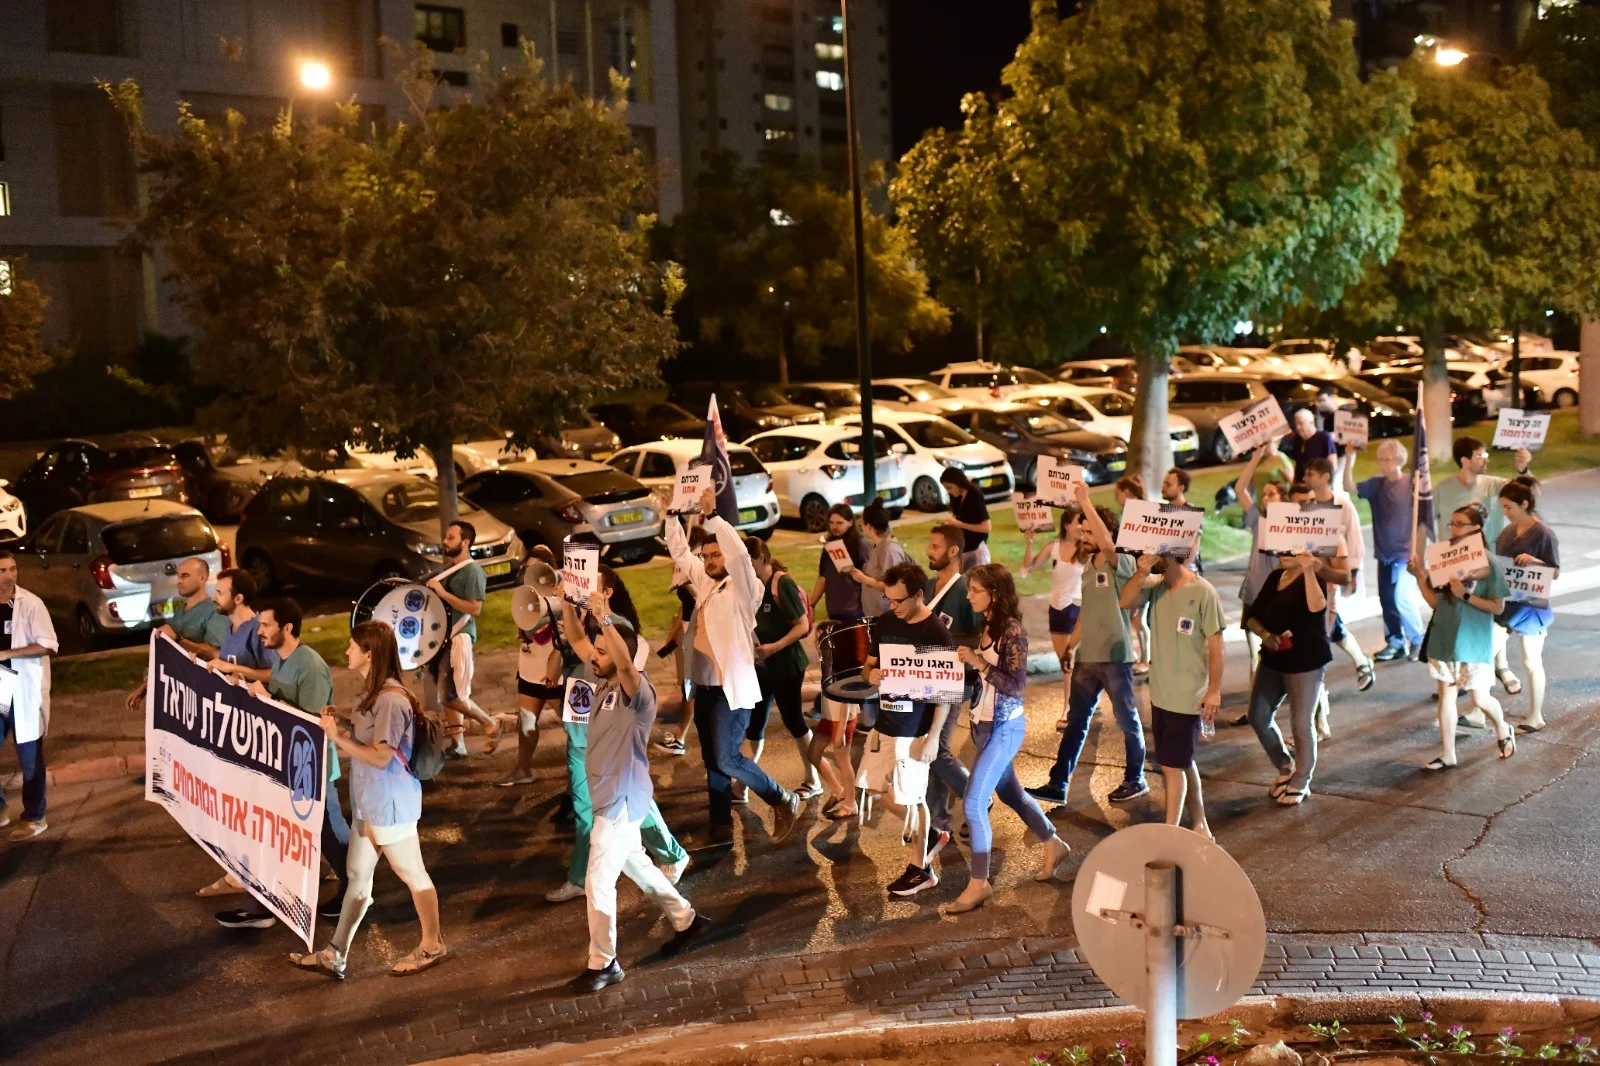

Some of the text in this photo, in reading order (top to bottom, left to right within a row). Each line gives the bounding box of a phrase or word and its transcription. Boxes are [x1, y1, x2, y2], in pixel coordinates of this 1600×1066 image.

[1231, 407, 1270, 431] זה קיצור
[1508, 418, 1542, 429] זה קיצור
[1233, 421, 1267, 443] מלחמה
[1500, 429, 1532, 439] מלחמה
[1048, 469, 1070, 481] מכרתם
[1050, 480, 1067, 491] אותנו
[1038, 511, 1048, 519] או
[1142, 515, 1184, 528] אין קיצור
[1285, 516, 1325, 526] אין קיצור
[1123, 522, 1195, 538] אין מתמחים/ות
[1269, 525, 1338, 536] אין מתמחים/ות
[574, 558, 587, 571] זה
[1505, 567, 1542, 580] זה קיצ
[580, 576, 590, 589] או
[1531, 584, 1544, 593] או
[890, 657, 954, 669] האגו שלכם
[881, 668, 964, 681] עולה בחיי אדם
[572, 685, 590, 708] 26
[160, 663, 283, 772] ממשלת ישראל
[293, 740, 312, 801] 26
[173, 760, 313, 870] הפקירה את המתמחים
